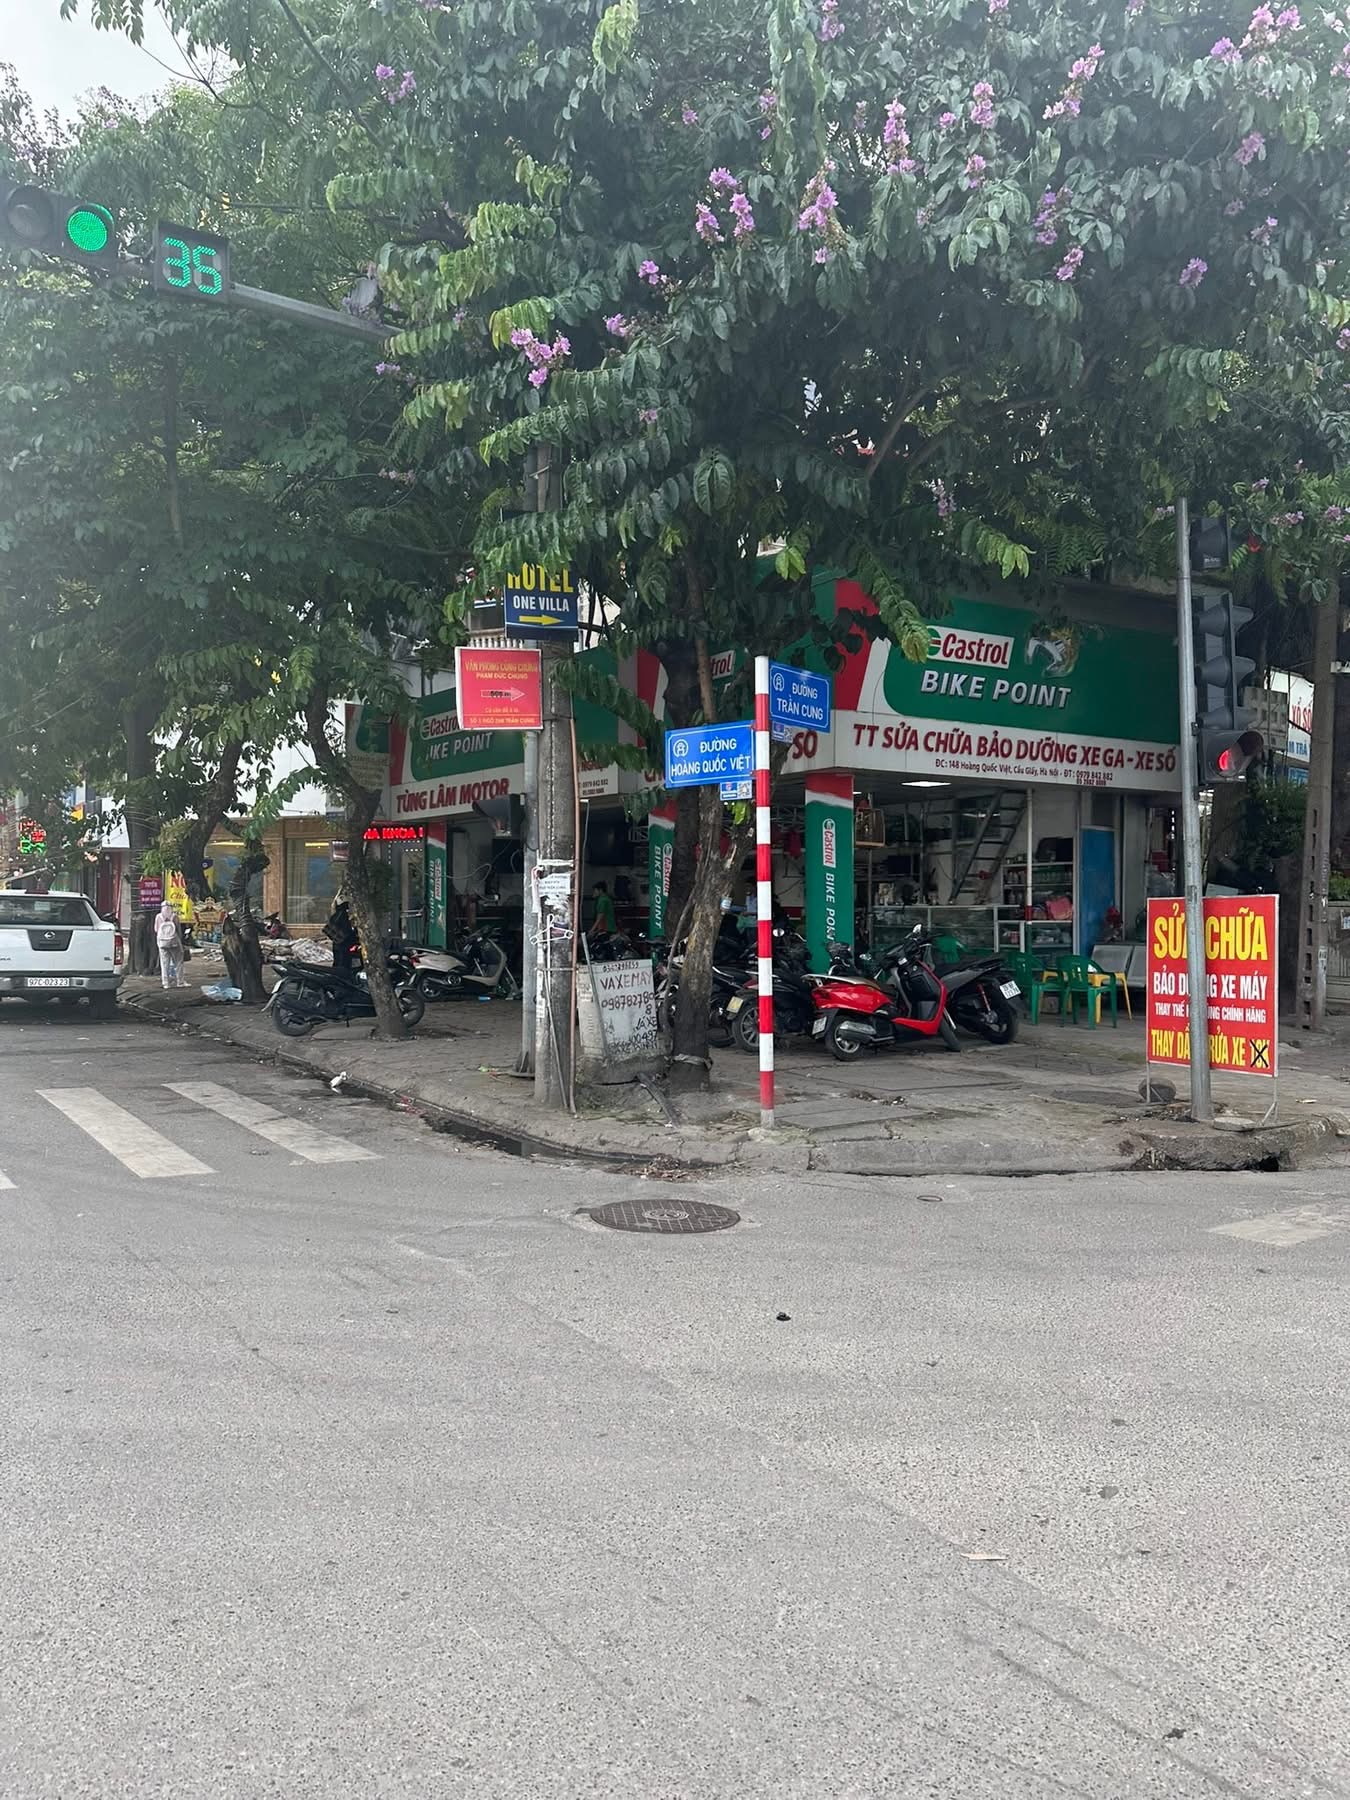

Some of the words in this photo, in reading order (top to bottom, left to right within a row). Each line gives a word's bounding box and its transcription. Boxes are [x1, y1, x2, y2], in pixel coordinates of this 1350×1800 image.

[513, 595, 536, 610] ONE
[539, 596, 569, 612] VILLA
[711, 652, 732, 676] trol
[942, 633, 1009, 665] Castrol
[792, 681, 818, 700] ĐƯỜNG
[921, 669, 986, 699] BIKE
[992, 679, 1072, 709] POINT
[777, 694, 799, 714] TRẦN
[801, 704, 823, 721] CUNG
[430, 715, 460, 736] Castro
[426, 742, 449, 760] IKE
[453, 732, 493, 756] POINT
[700, 738, 737, 754] ĐƯỜNG
[853, 723, 879, 747] TT
[881, 721, 919, 751] SỬA
[923, 727, 972, 755] CHỮA
[976, 730, 1013, 759] BẢO
[1015, 736, 1077, 764] DƯỠNG
[671, 759, 701, 777] HOÀNG
[702, 755, 726, 774] QUỐC
[730, 755, 751, 772] VIỆT
[396, 789, 427, 814] TÙNG
[429, 783, 457, 809] LÂM
[459, 777, 510, 805] MOTOR
[654, 845, 662, 878] BIKE
[824, 830, 834, 864] Castrol
[826, 872, 835, 903] BIKE
[654, 884, 662, 929] POINT
[1153, 902, 1188, 960] SỬ
[1205, 906, 1268, 961] CHỮA
[1153, 964, 1176, 995] BẢO
[1221, 974, 1237, 999] XE
[1240, 970, 1268, 1001] MÁY
[1155, 1002, 1172, 1016] THAY
[1172, 999, 1186, 1018] THẾ
[1221, 1003, 1244, 1022] CHÍNH
[1245, 1005, 1267, 1023] HÃNG
[1151, 1029, 1175, 1058] THAY
[1231, 1036, 1246, 1067] XE
